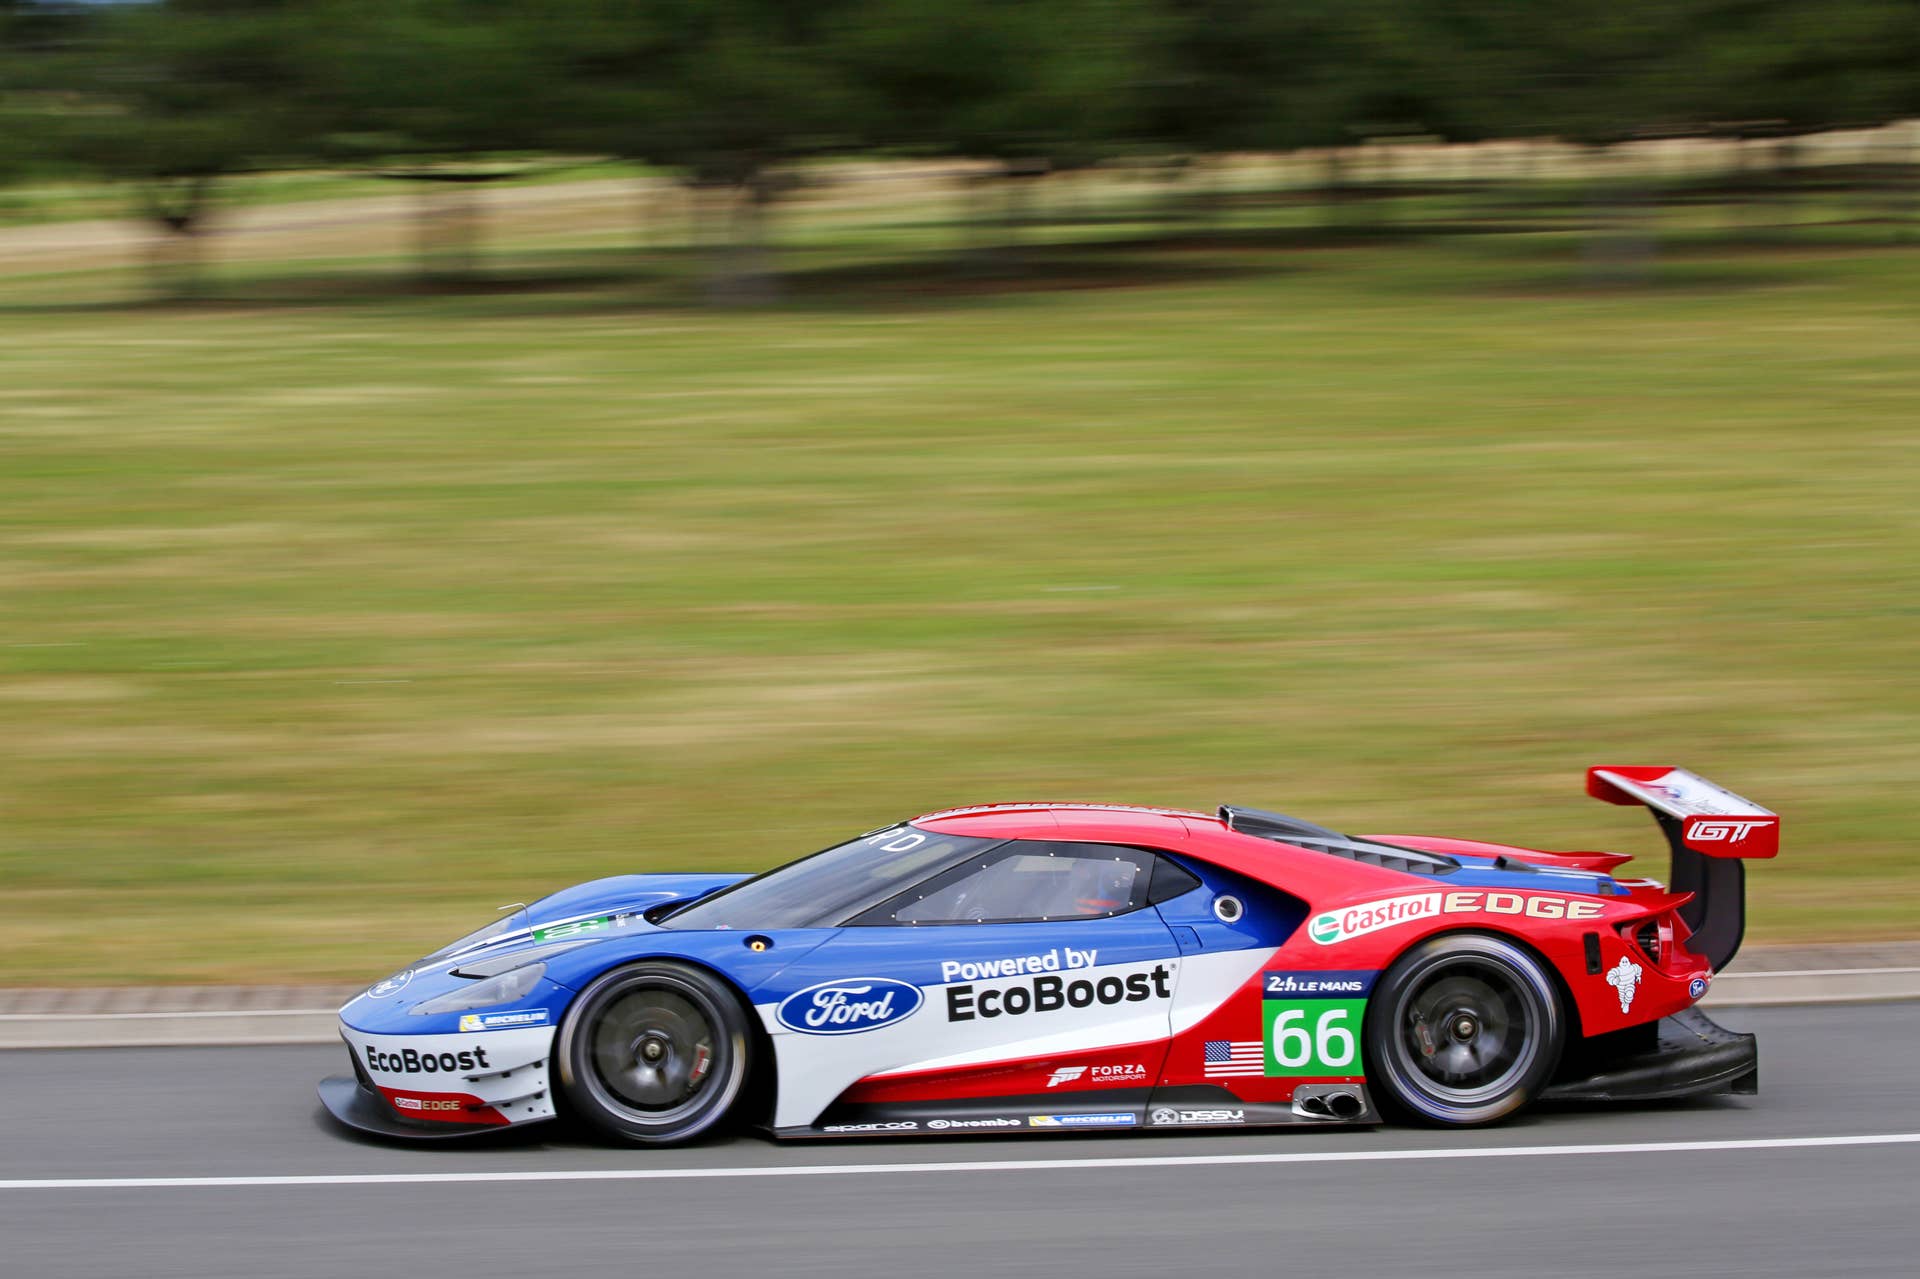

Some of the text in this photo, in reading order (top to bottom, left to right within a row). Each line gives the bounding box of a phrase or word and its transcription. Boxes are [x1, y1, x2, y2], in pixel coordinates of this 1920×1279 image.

[1686, 821, 1774, 843] GT
[1343, 892, 1605, 935] Castrol EDGE
[943, 948, 1097, 982] Powered by
[946, 965, 1171, 1022] EcoBoost
[1299, 981, 1318, 992] LE
[1319, 981, 1363, 992] MANS
[804, 985, 897, 1027] Ford
[1272, 1009, 1355, 1068] 66
[366, 1045, 490, 1073] EcoBoost
[1091, 1064, 1146, 1075] FORZA
[1091, 1073, 1146, 1082] MOTORSPORT
[422, 1100, 461, 1111] EDGE
